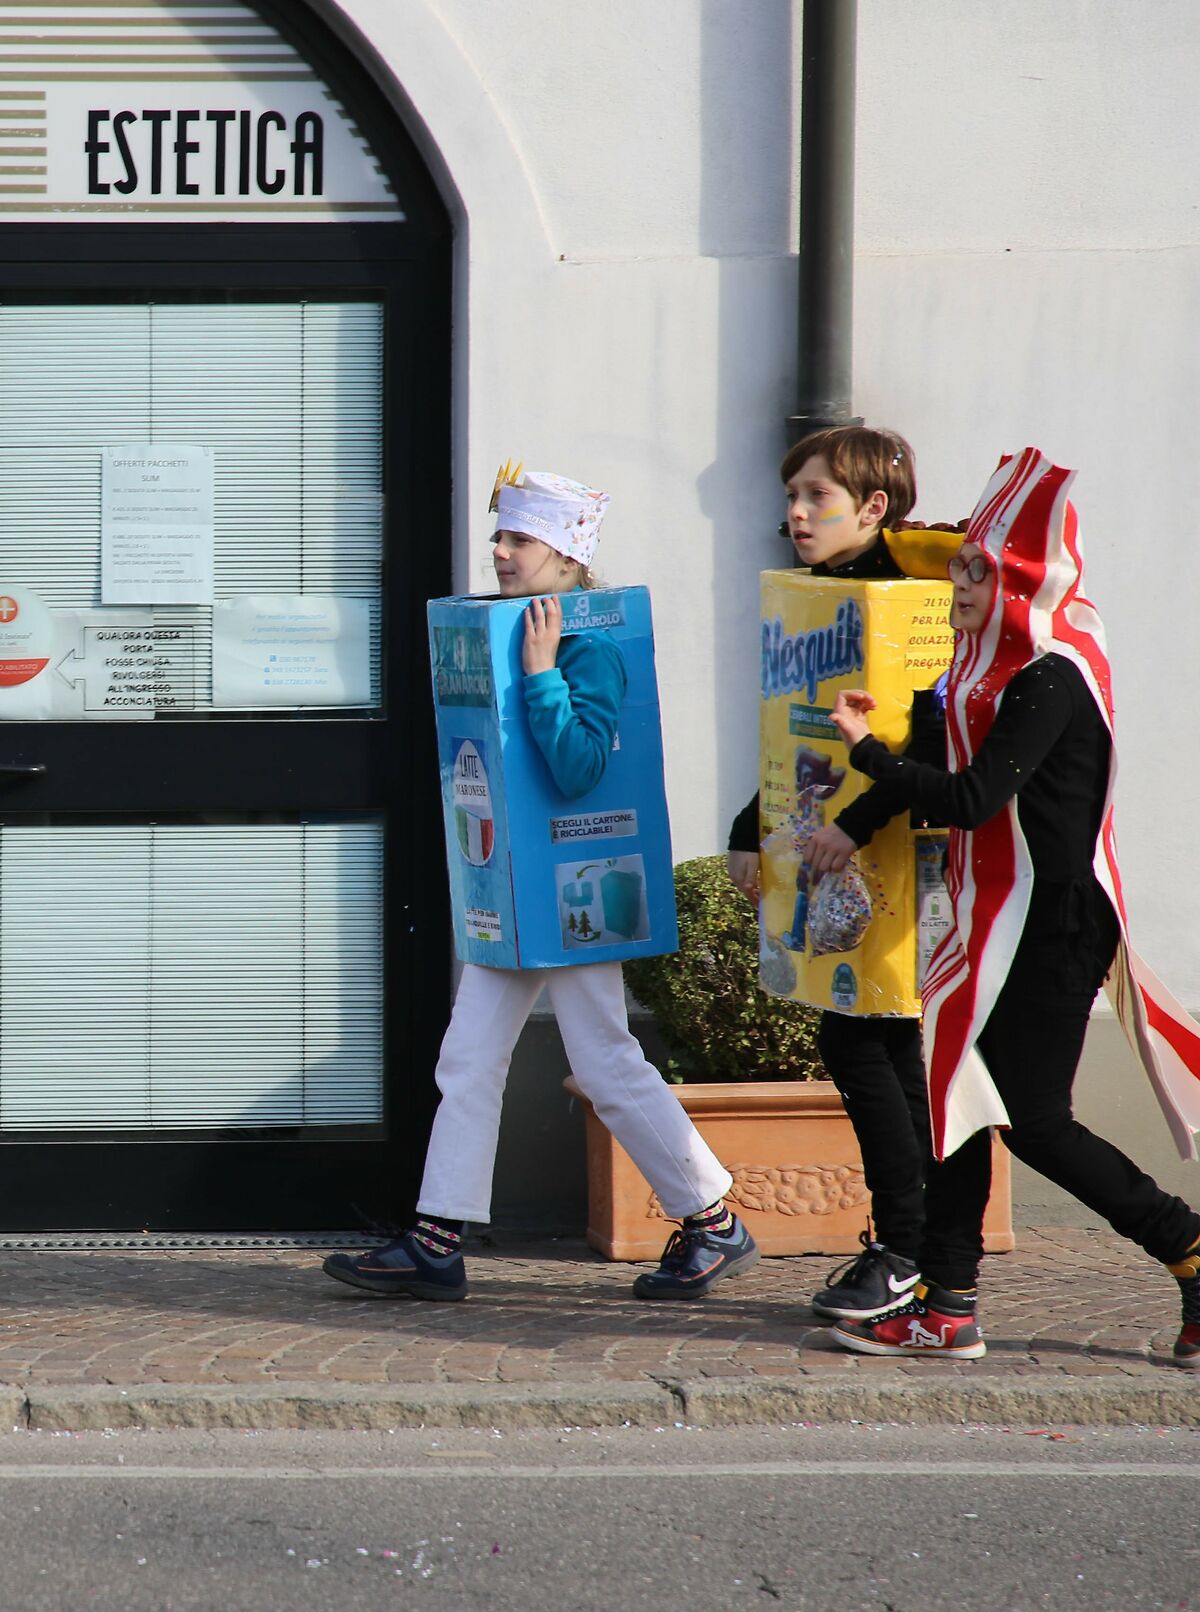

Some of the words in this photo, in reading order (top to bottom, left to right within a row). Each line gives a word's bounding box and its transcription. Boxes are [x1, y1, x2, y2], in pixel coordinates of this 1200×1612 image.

[84, 110, 324, 196] ESTETICA
[112, 460, 146, 468] OFFERTE
[147, 460, 189, 468] PACCHETTI
[560, 613, 620, 631] RANAROLO
[912, 616, 933, 625] PER
[935, 616, 948, 625] LA
[97, 631, 141, 640] QUALORA
[143, 631, 180, 640] QUESTA
[908, 635, 955, 645] COLAZIO
[123, 644, 153, 653] PORTA
[762, 597, 864, 704] Nesquik
[105, 658, 135, 667] FOSSE
[905, 658, 953, 669] PREGASS
[112, 671, 166, 680] RIVOLGERSI
[103, 697, 176, 706] ACCONCIATURA
[460, 754, 479, 779] LATTE
[551, 819, 582, 829] SCEGLI
[584, 818, 591, 826] IL
